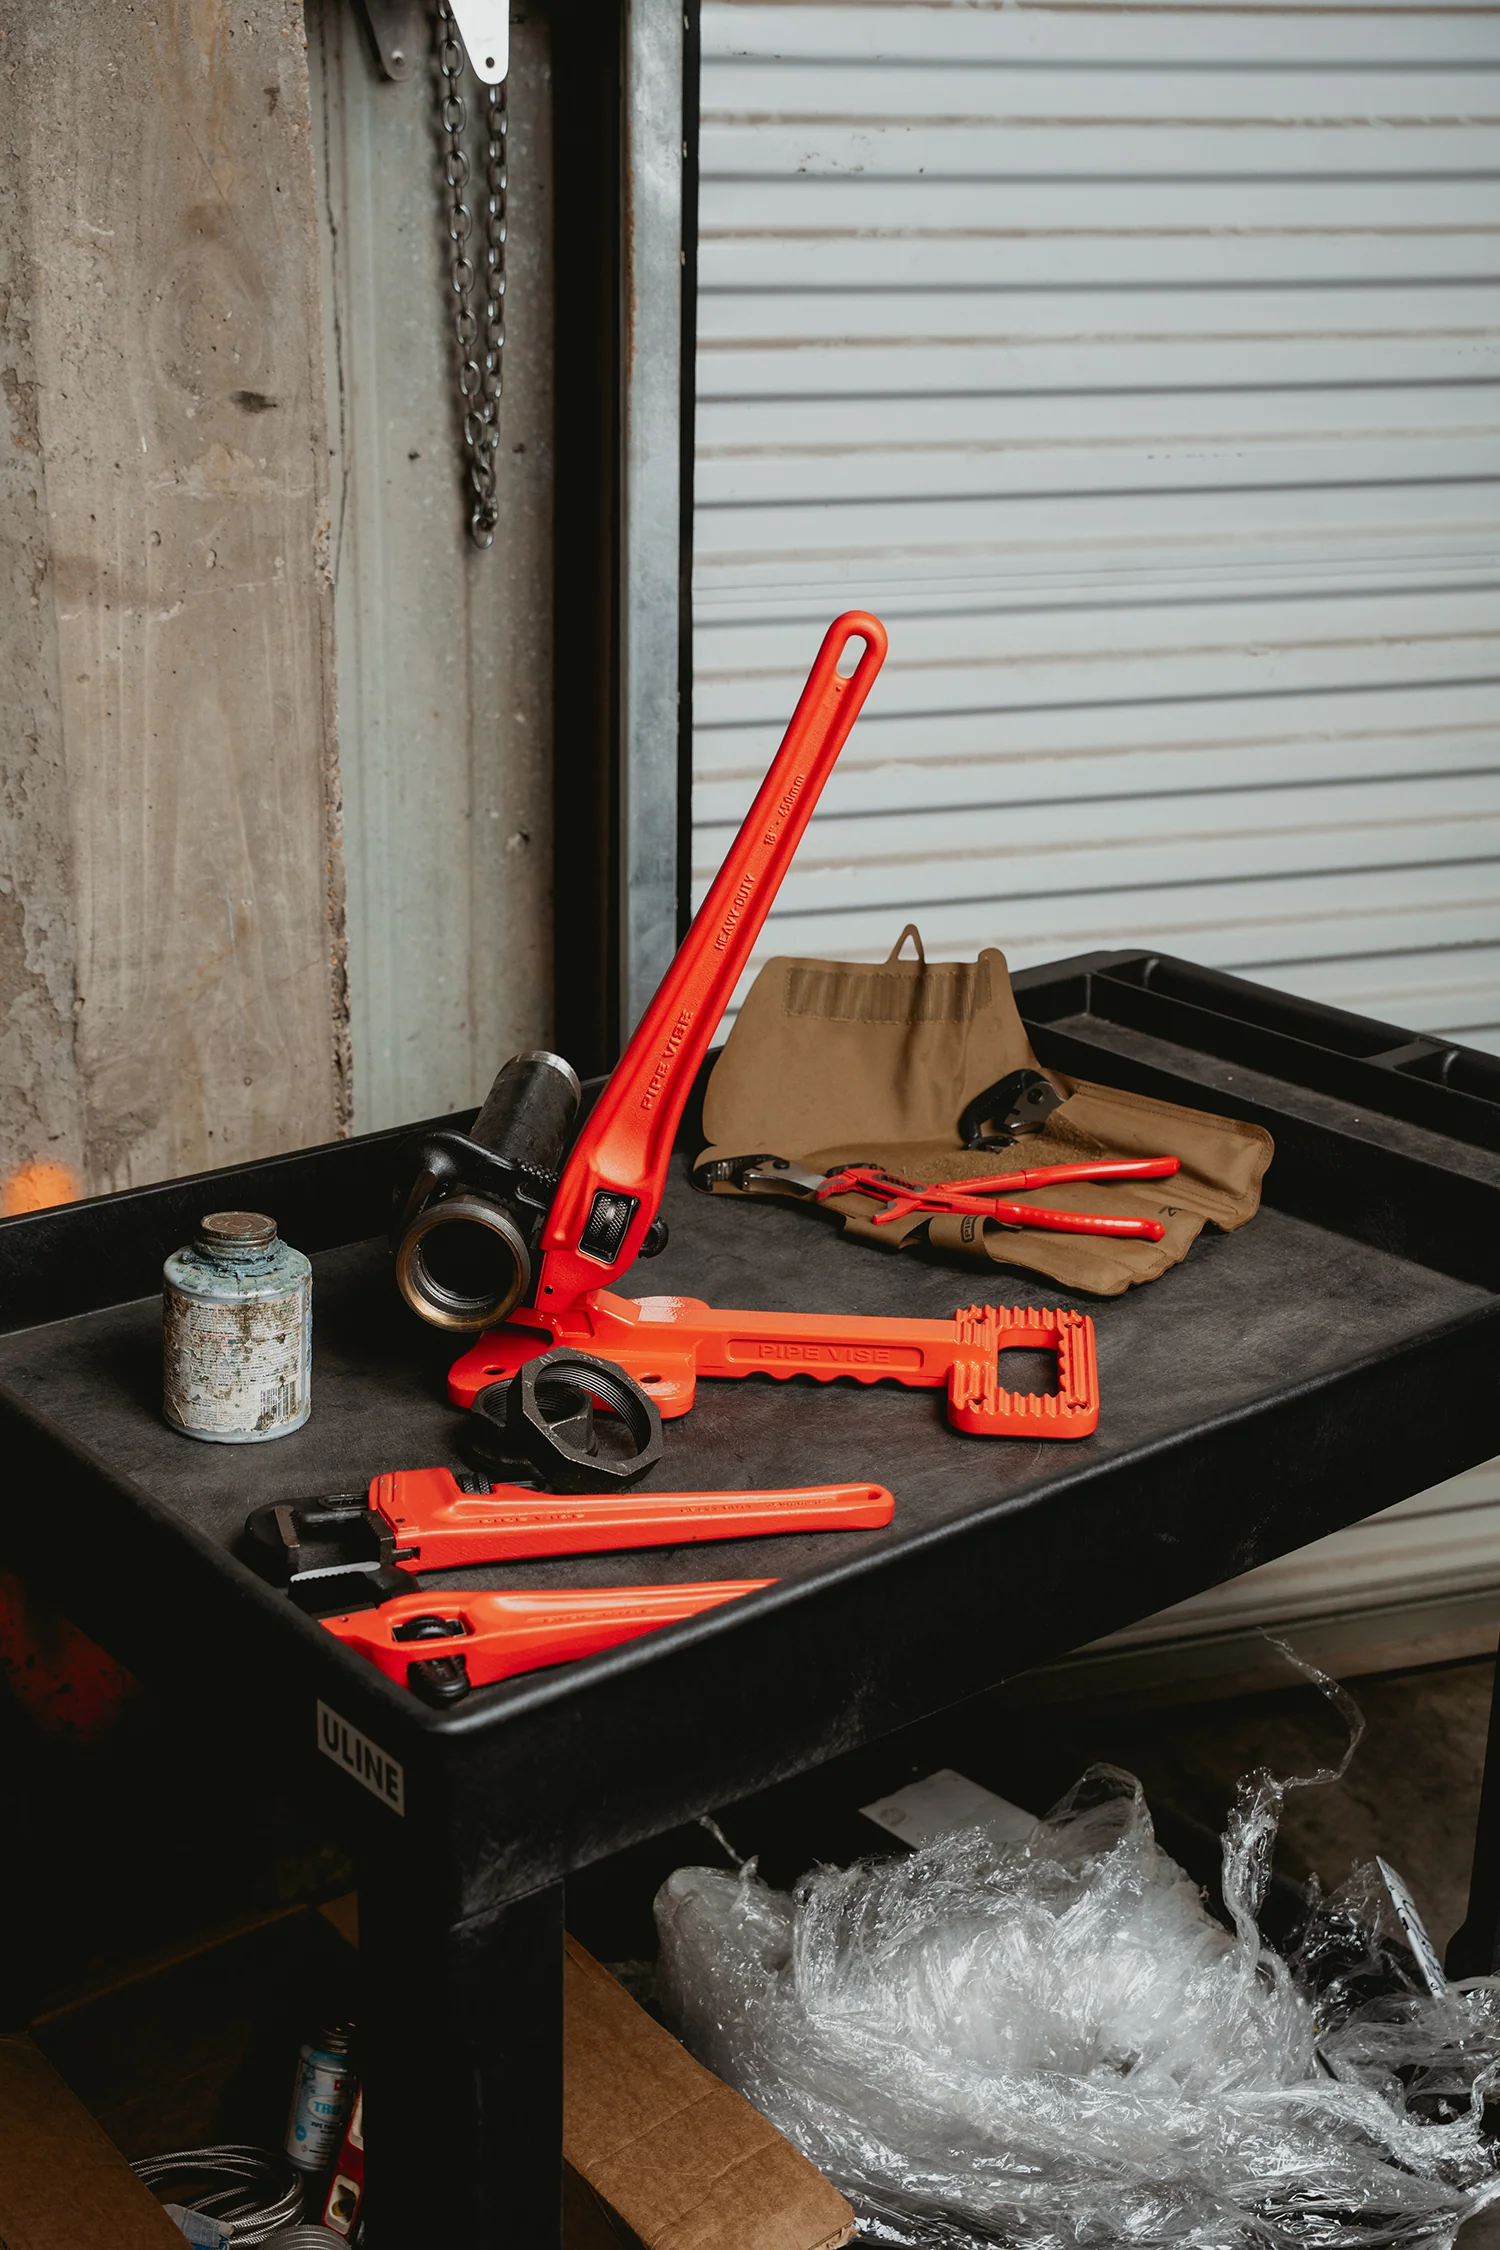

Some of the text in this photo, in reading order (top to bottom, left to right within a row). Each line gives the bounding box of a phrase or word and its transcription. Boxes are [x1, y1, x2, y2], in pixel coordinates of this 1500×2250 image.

[640, 1010, 693, 1110] PIPE VISE
[758, 1344, 889, 1363] PIPE VISE
[323, 1710, 399, 1803] ULINE
